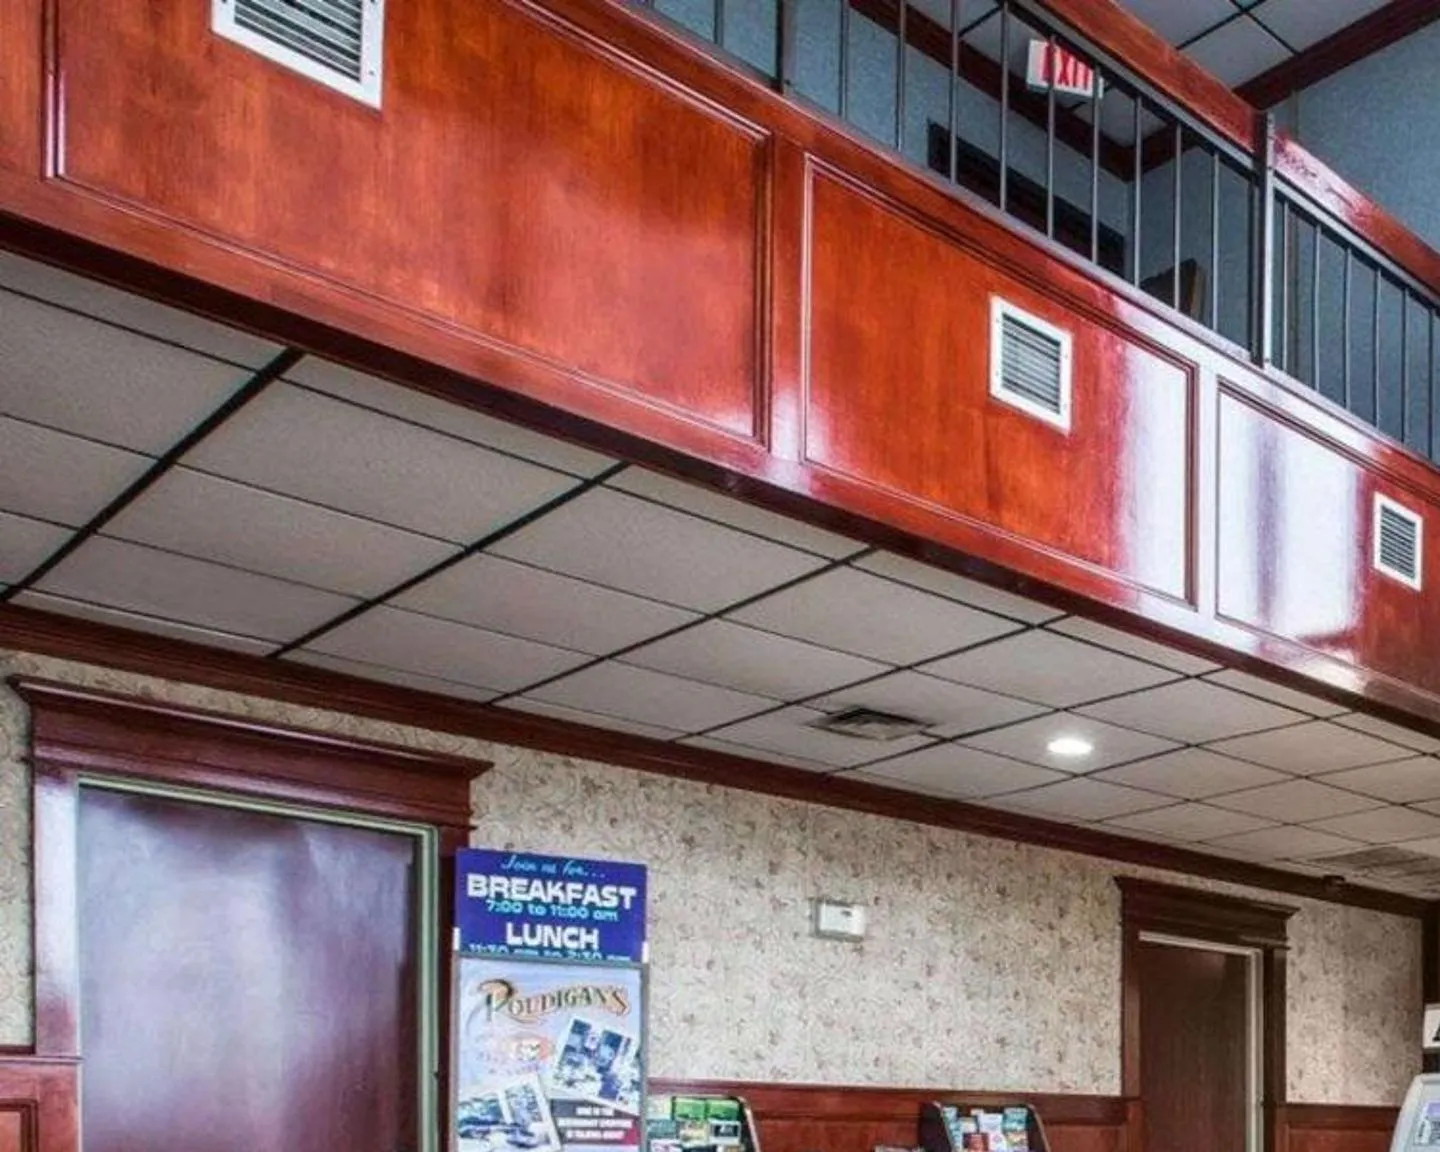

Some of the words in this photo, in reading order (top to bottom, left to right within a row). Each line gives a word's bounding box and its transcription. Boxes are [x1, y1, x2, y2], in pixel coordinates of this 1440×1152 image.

[501, 854, 537, 872] Join
[541, 863, 558, 875] us
[467, 873, 637, 910] BREAKFAST
[486, 899, 523, 914] 7:00
[528, 903, 547, 916] to
[551, 904, 590, 919] 11:00
[593, 909, 618, 922] am
[506, 922, 600, 951] LUNCH
